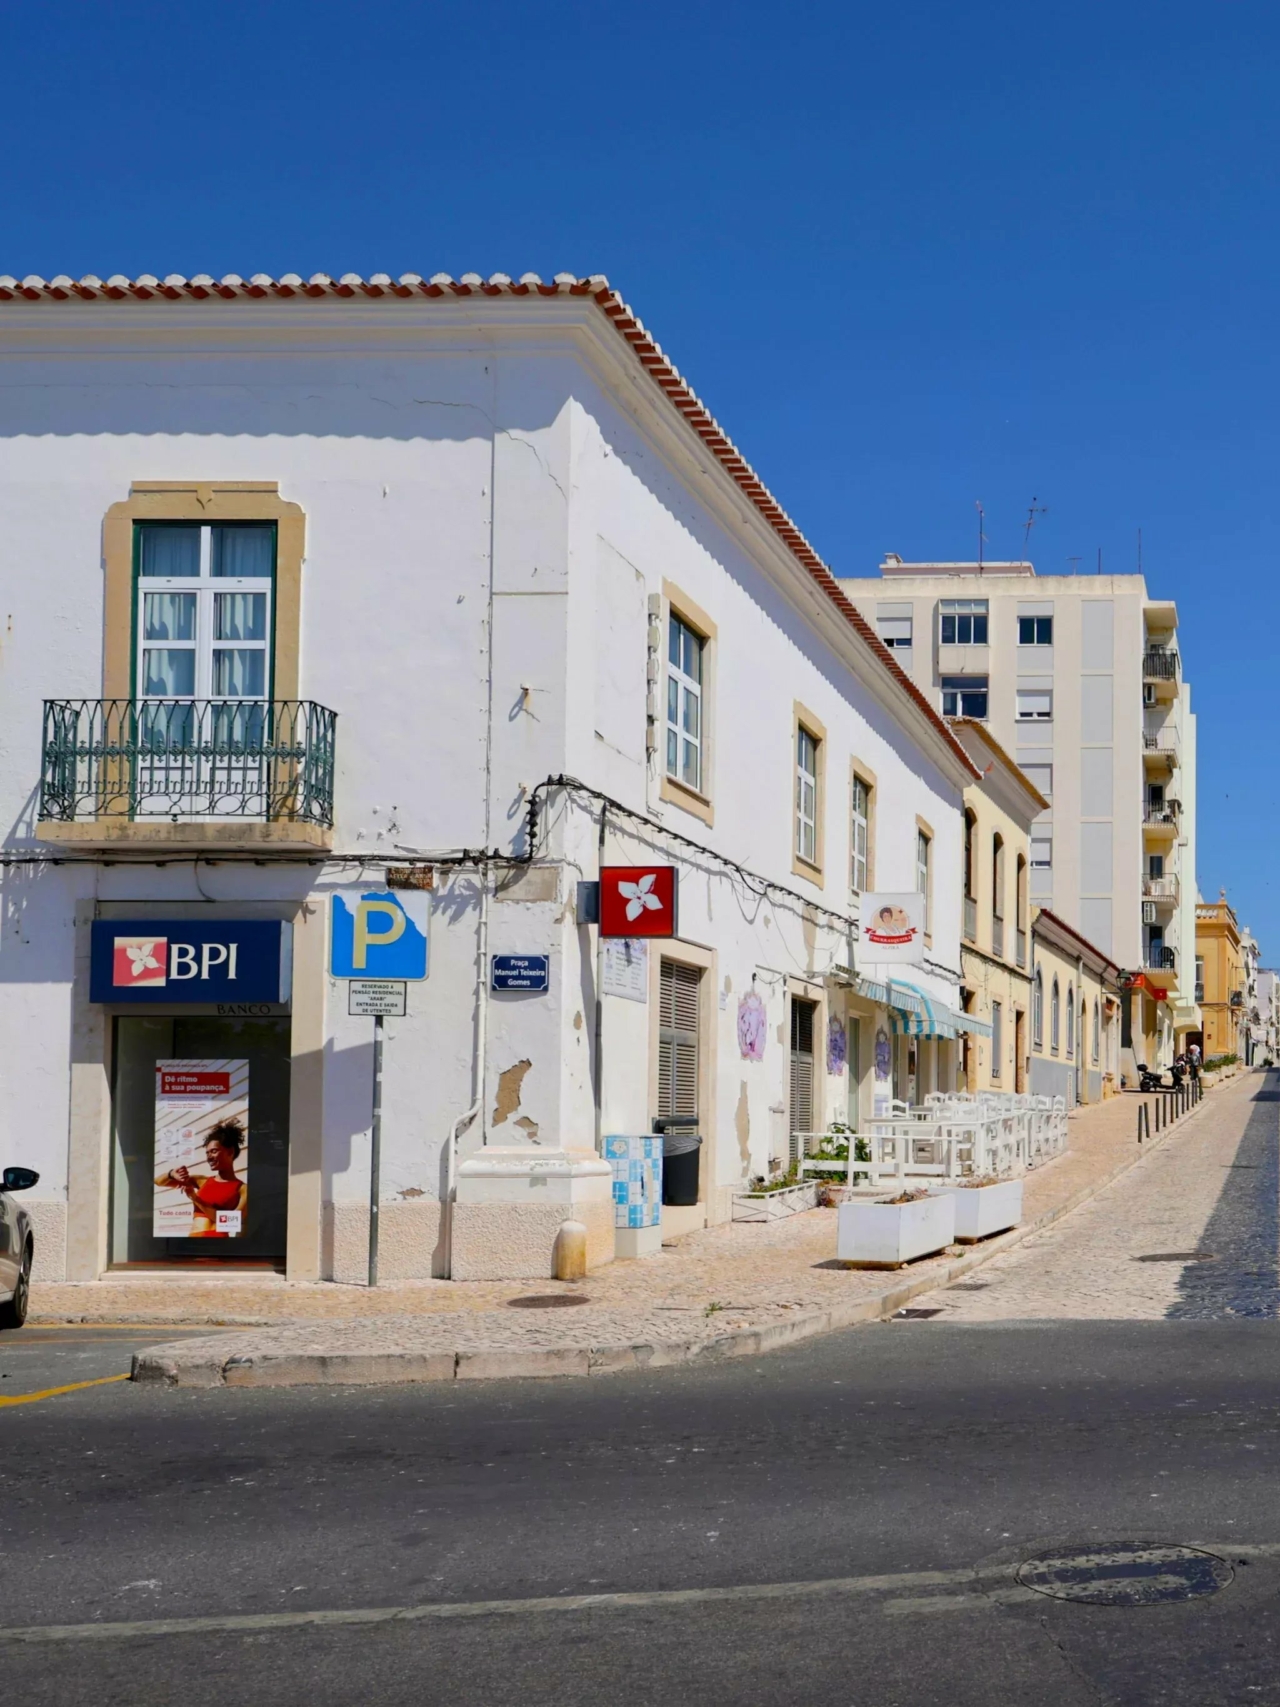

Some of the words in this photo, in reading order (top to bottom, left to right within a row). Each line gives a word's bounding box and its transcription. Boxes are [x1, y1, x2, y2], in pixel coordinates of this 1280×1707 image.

[353, 901, 406, 969] P
[169, 943, 238, 979] BPI
[510, 959, 529, 968] Praça
[520, 969, 545, 977] Teixeira
[217, 1004, 271, 1015] BANCO
[164, 1075, 175, 1083] Dê
[177, 1075, 198, 1083] ritmo
[186, 1085, 226, 1093] poupança.
